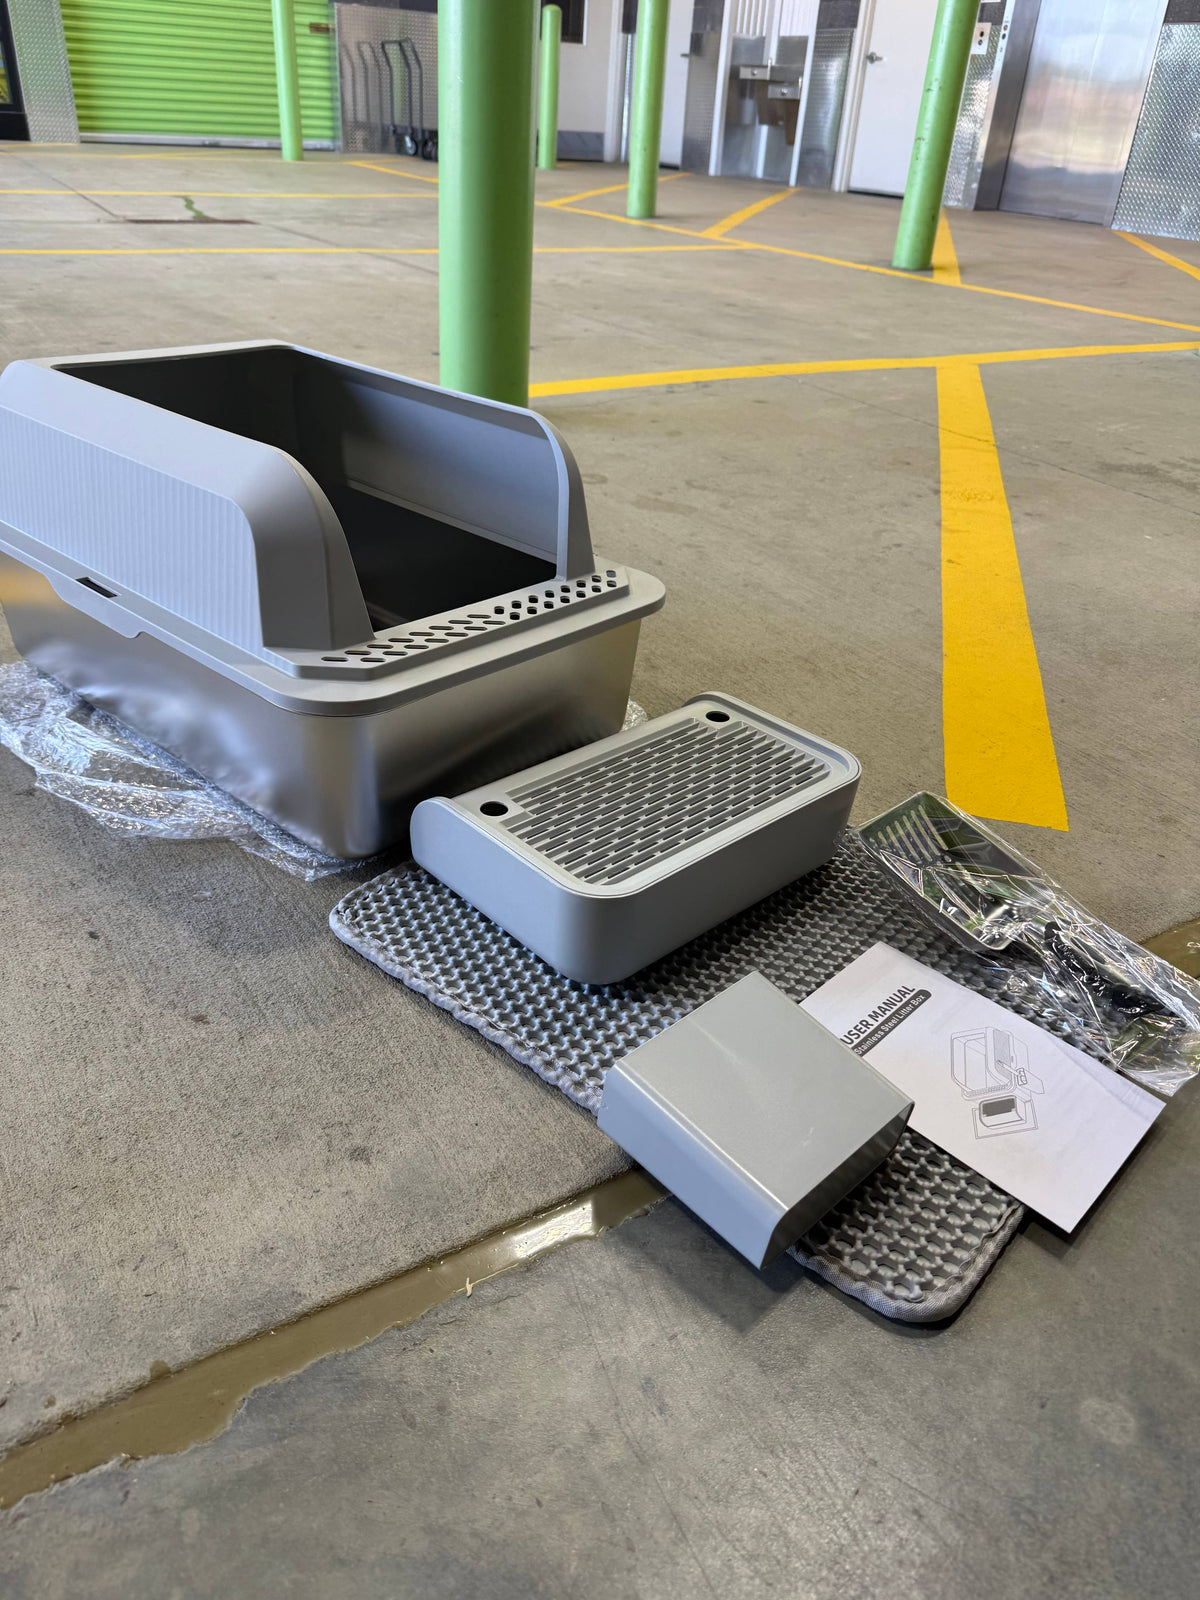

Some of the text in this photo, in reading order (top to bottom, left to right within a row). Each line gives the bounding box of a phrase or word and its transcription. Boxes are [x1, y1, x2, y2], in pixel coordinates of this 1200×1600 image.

[840, 986, 915, 1045] USER MANUAL
[854, 994, 926, 1055] Stainless Steel Litter Box
